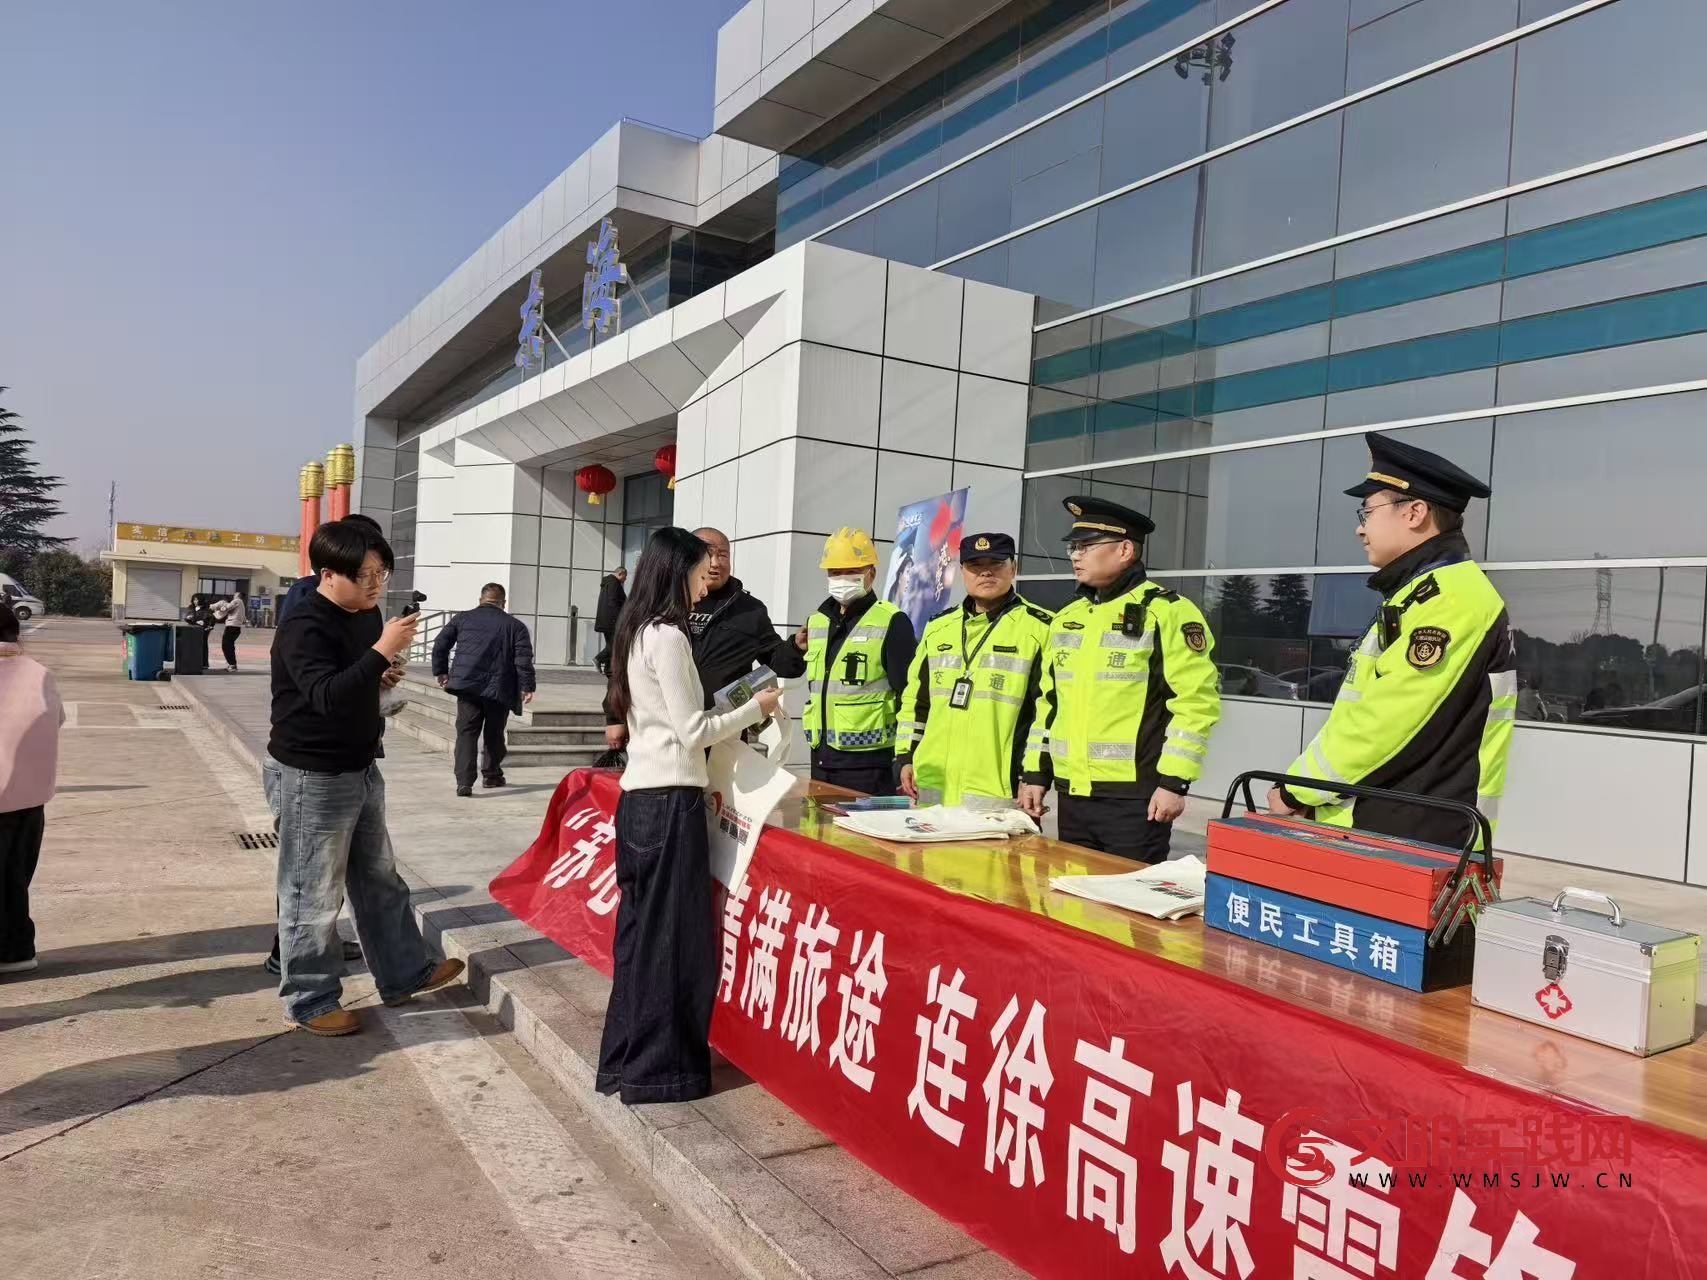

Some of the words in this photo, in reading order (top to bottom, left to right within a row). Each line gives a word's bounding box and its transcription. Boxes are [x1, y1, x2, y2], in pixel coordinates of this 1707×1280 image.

[1056, 650, 1127, 668] 交通
[1226, 892, 1400, 973] 便民工具箱
